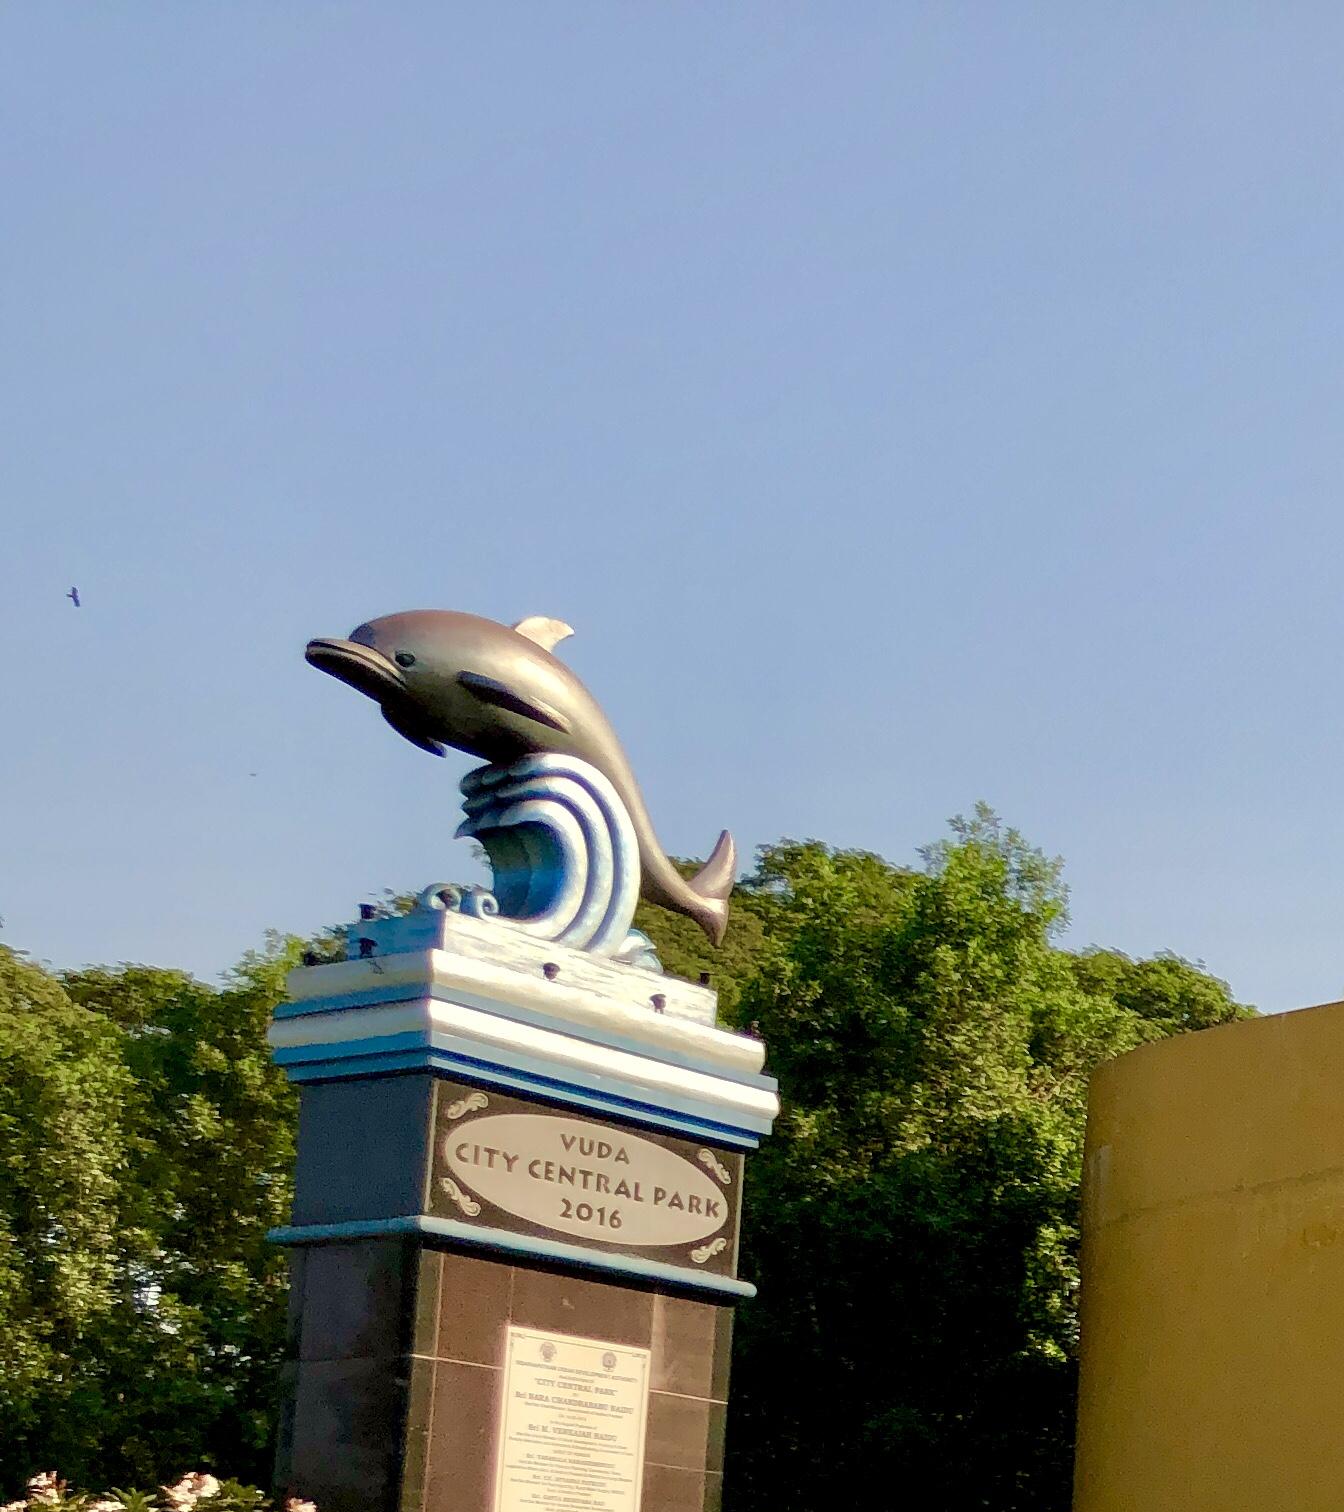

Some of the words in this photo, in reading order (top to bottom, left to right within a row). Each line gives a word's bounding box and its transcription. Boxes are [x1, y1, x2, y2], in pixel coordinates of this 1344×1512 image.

[560, 1133, 630, 1165] VUDA
[455, 1142, 519, 1173] CITY
[528, 1159, 645, 1202] CENTRAL
[653, 1185, 720, 1219] PARK
[559, 1198, 623, 1229] 2016
